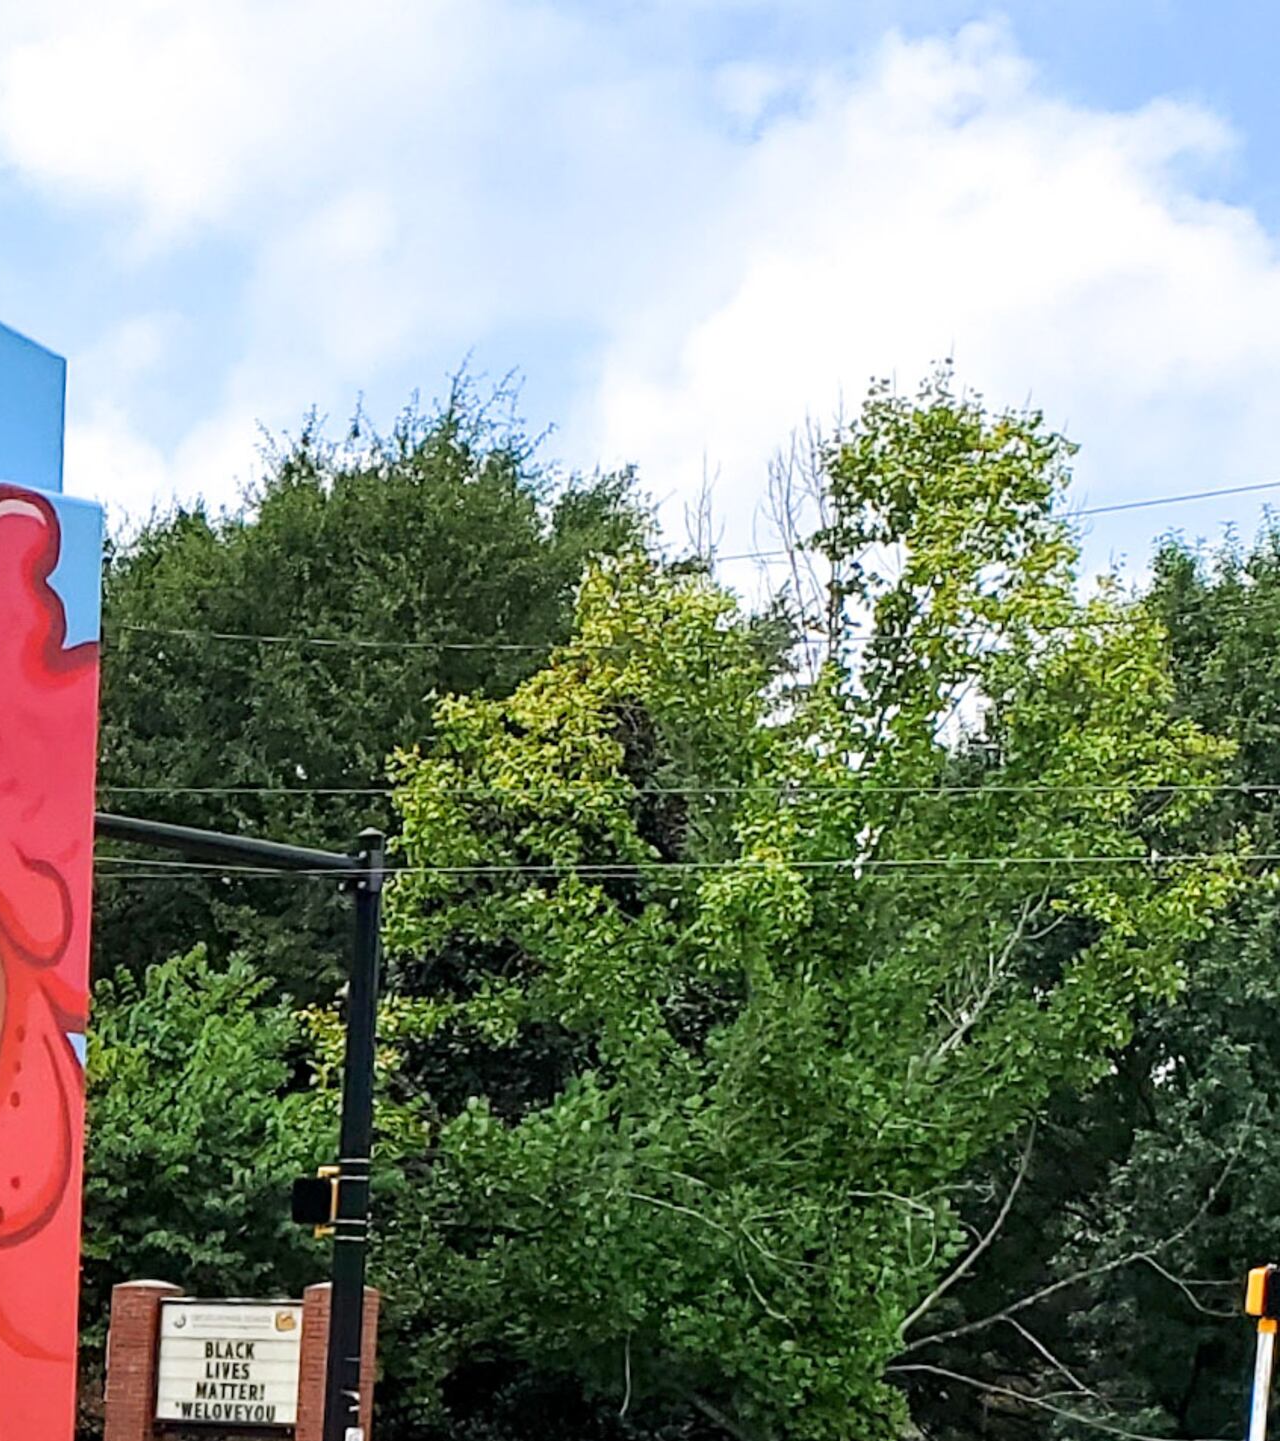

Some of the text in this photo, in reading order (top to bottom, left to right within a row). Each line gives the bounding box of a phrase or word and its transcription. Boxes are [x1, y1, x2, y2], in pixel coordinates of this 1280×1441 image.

[204, 1341, 255, 1360] BLACK
[205, 1362, 250, 1380] LIVES
[195, 1382, 266, 1401] MATTER!
